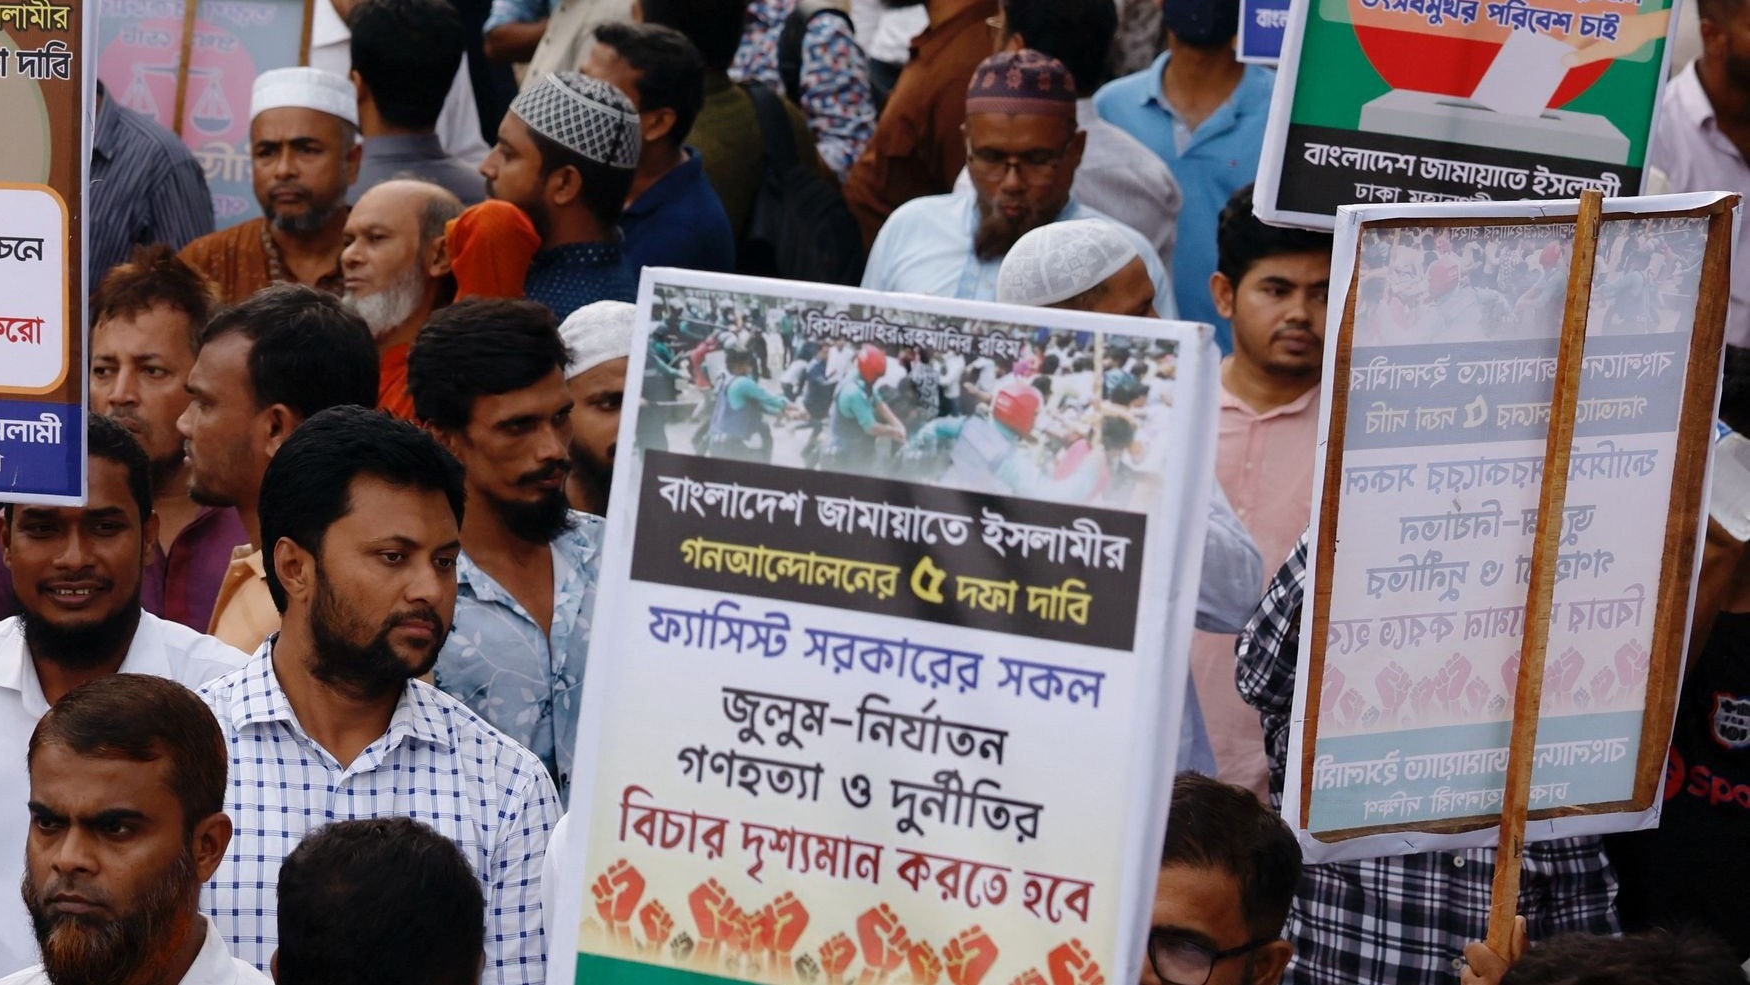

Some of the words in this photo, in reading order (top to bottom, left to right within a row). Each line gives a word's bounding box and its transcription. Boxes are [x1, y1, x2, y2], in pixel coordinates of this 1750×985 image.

[15, 40, 72, 80] দাবি
[1579, 9, 1619, 40] চাই
[1304, 143, 1417, 176] বাংলাদেশ
[1420, 157, 1529, 190] জামায়াতে
[1354, 183, 1401, 207] ঢাকা
[979, 337, 1021, 361] রহিম
[658, 476, 807, 526] বাংলাদেশ
[816, 496, 972, 546] জামায়াতে
[980, 508, 1131, 571] ইসলামীর
[681, 538, 900, 599] গনআন্দোলনের
[911, 557, 945, 602] ৫
[951, 576, 1020, 620] দফা
[1027, 579, 1091, 624] দাবি
[649, 600, 791, 657] ফ্যাসিস্ট
[804, 628, 984, 693] সরকারের
[998, 658, 1105, 708] সকল
[722, 687, 1009, 765] জুলুম-নির্যাতন
[678, 745, 824, 801] গণহত্যা
[841, 774, 871, 809] ও
[890, 770, 1044, 843] দুর্নীতির
[620, 785, 729, 859] বিচার
[741, 823, 884, 884] দৃশ্যমান
[896, 849, 1011, 908] করতে
[1024, 872, 1094, 923] হবে
